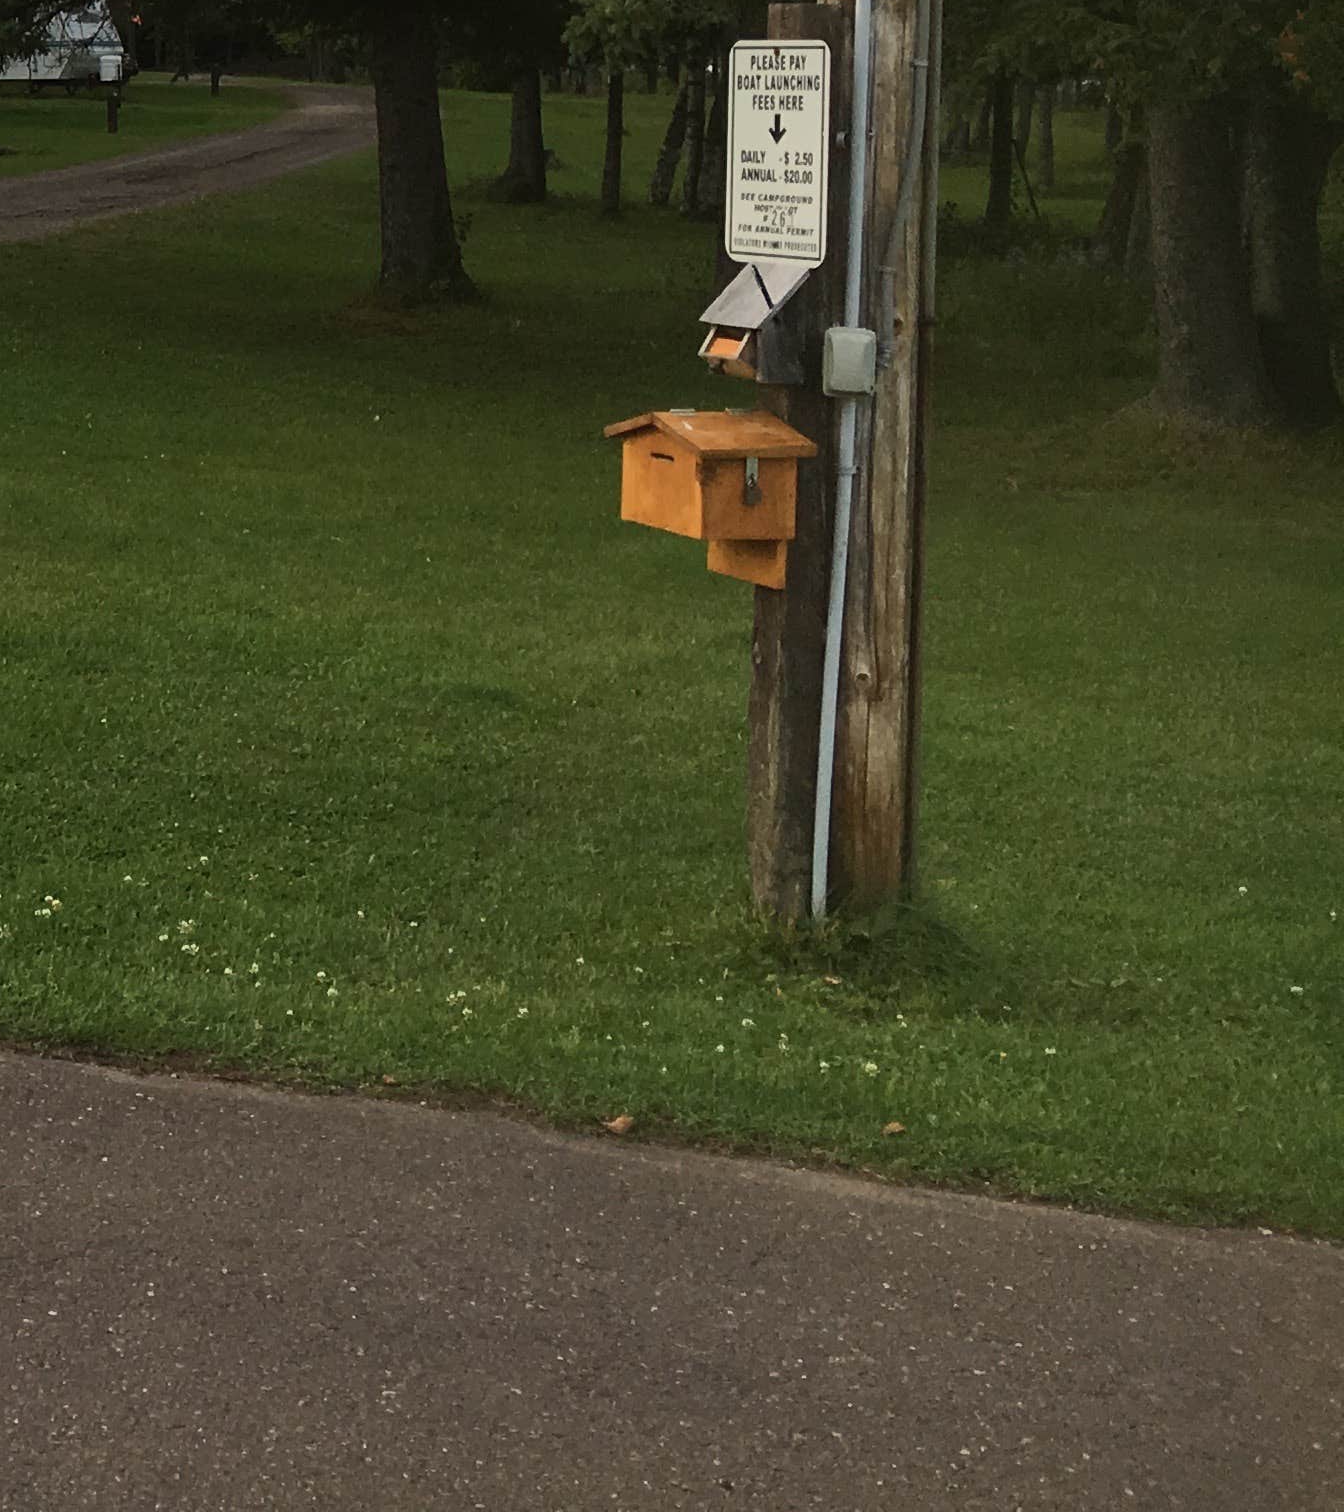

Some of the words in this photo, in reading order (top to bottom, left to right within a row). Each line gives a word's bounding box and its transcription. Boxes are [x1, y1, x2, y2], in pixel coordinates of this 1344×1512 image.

[750, 55, 786, 70] PLEASE
[789, 55, 807, 70] PAY
[737, 75, 761, 90] BOAT
[765, 75, 820, 91] LAUNCHING
[752, 94, 775, 110] FEES
[779, 95, 804, 111] HERE
[741, 150, 766, 164] DAILY
[794, 152, 813, 166] 2.50
[741, 168, 777, 183] ANNUAL
[784, 170, 813, 185] $20.00
[741, 192, 755, 200] SEE
[758, 193, 813, 204] CAMPGROUND
[738, 224, 752, 232] FOR
[755, 225, 783, 235] ANNUAL
[786, 227, 814, 236] PERMIT
